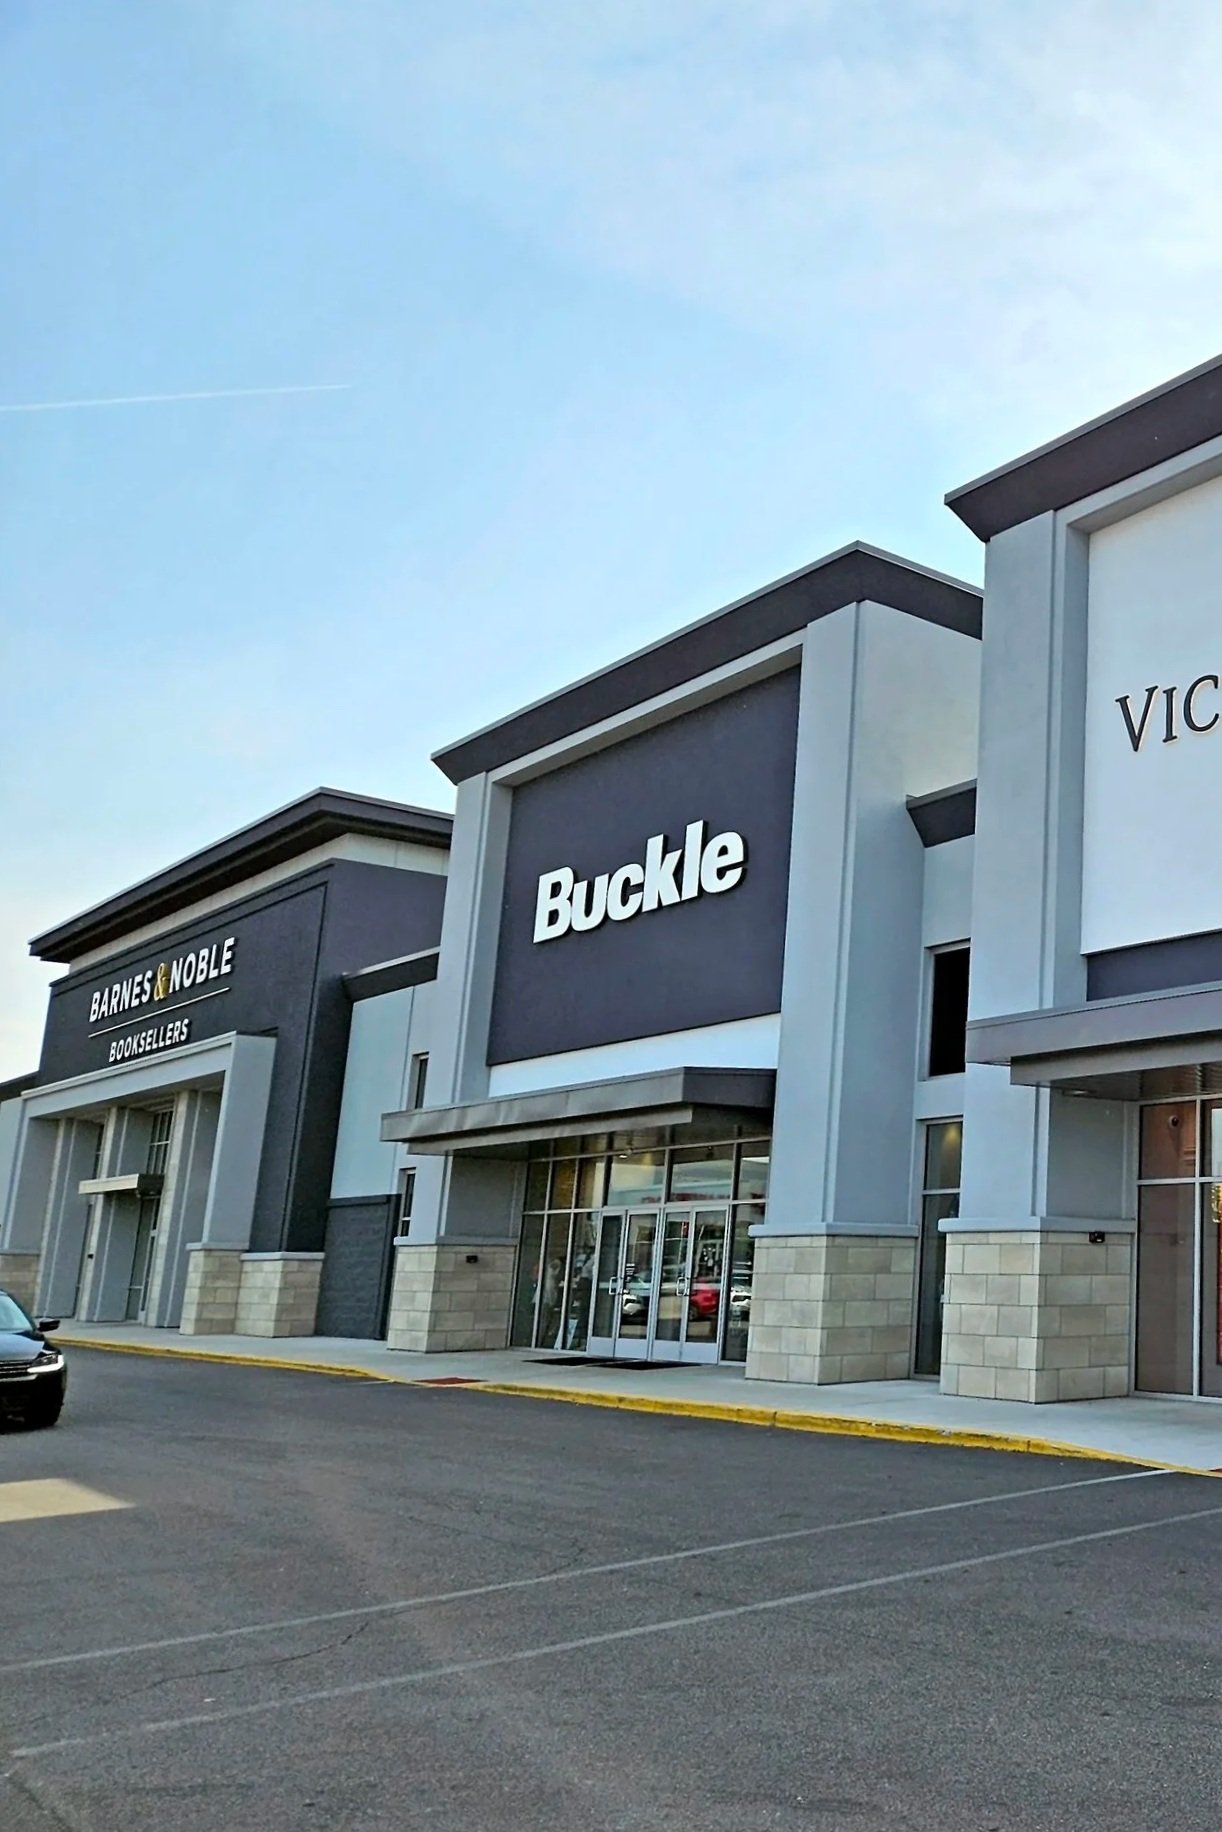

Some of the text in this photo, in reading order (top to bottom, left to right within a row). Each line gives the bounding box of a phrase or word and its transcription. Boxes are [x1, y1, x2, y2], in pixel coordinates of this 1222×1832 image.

[532, 819, 745, 945] Buckle
[88, 936, 236, 1023] BARNES & NOBLE
[108, 1018, 190, 1063] BOOKSELLERS
